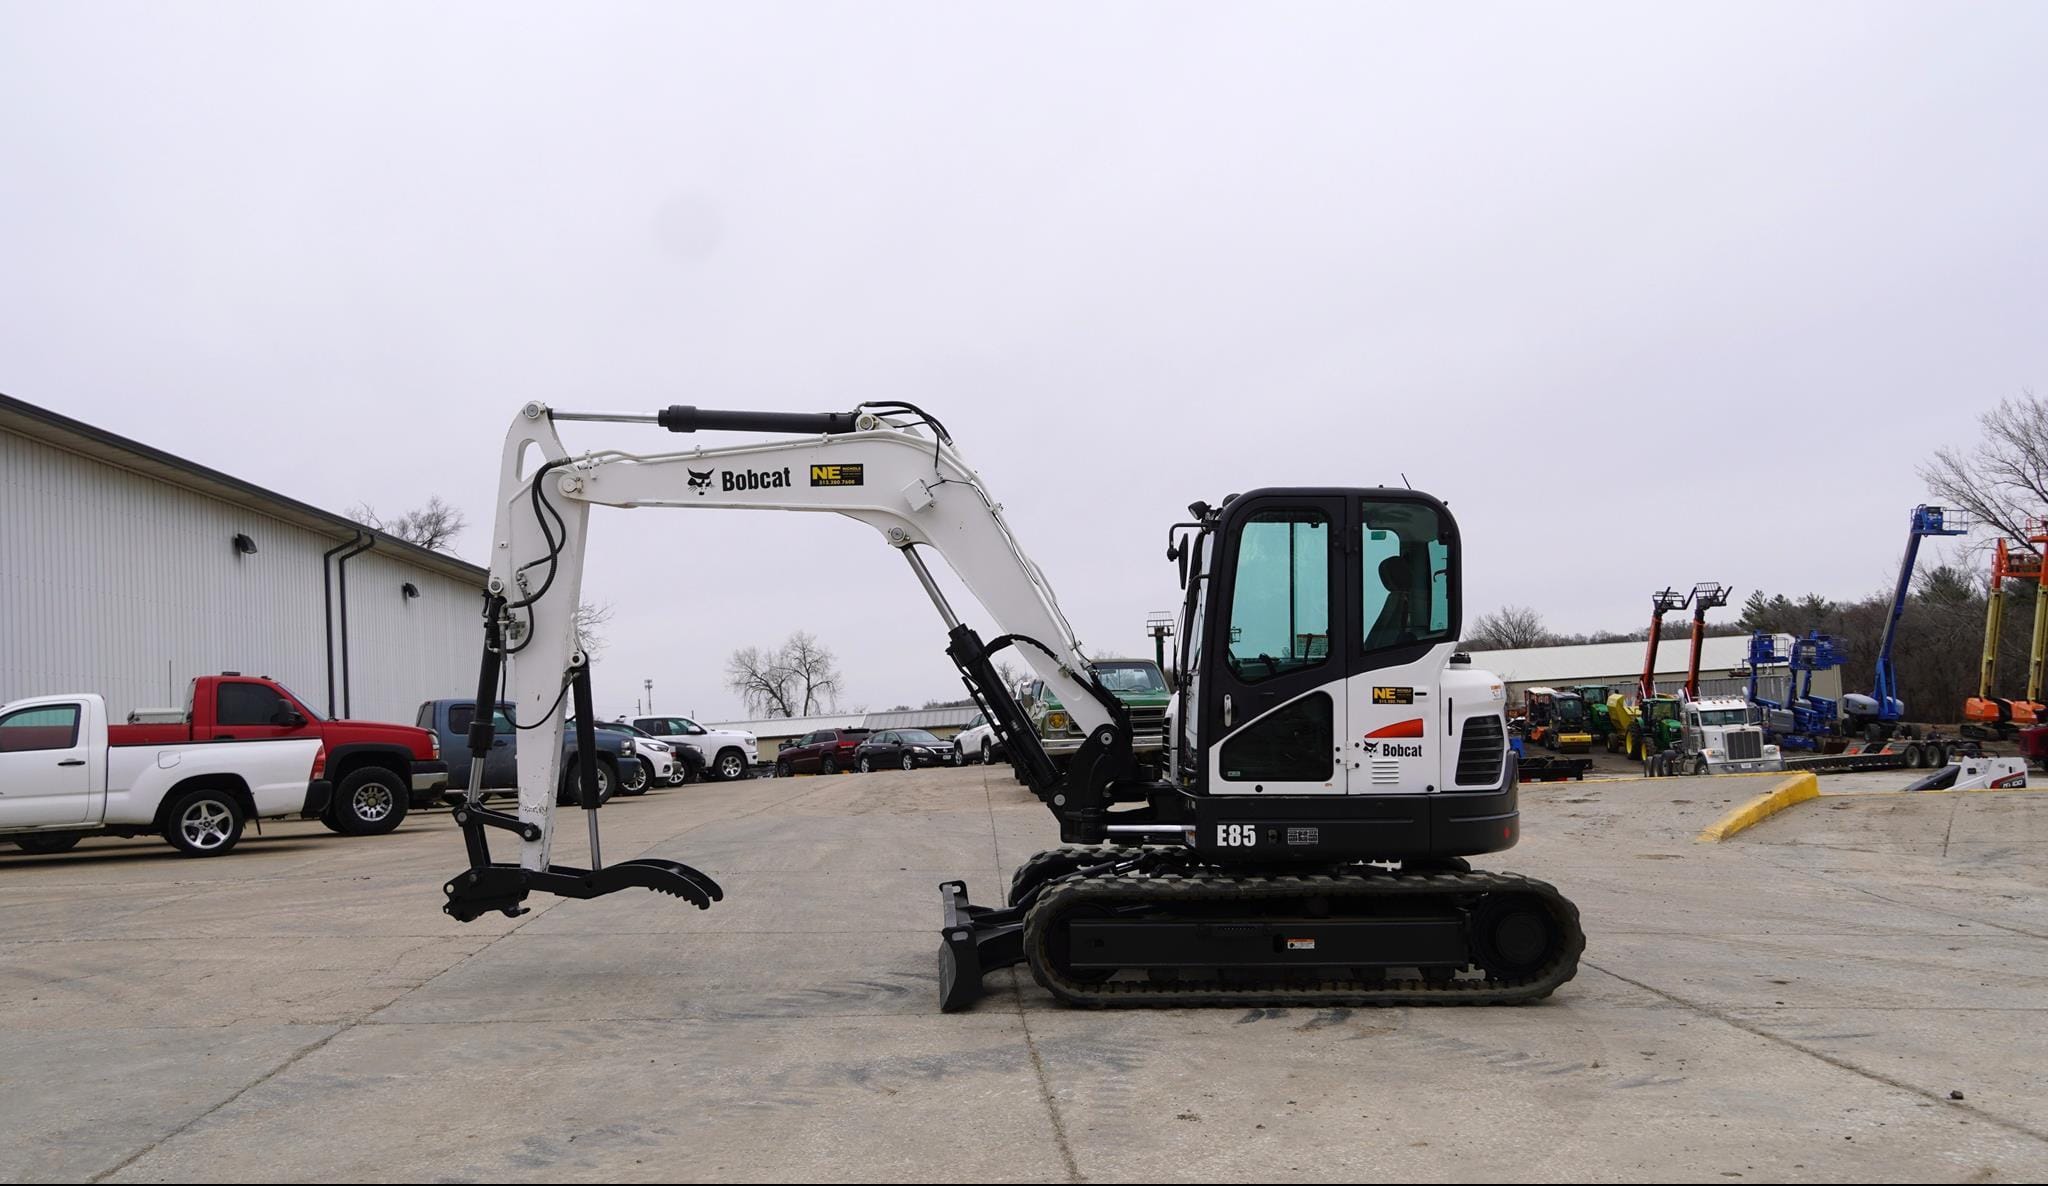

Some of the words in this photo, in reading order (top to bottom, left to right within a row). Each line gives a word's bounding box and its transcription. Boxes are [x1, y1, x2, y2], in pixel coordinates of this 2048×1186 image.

[722, 467, 791, 491] Bobcat
[812, 467, 841, 480] NE
[1373, 688, 1396, 699] NE
[1383, 744, 1422, 757] Bobcat
[1217, 825, 1256, 847] E85
